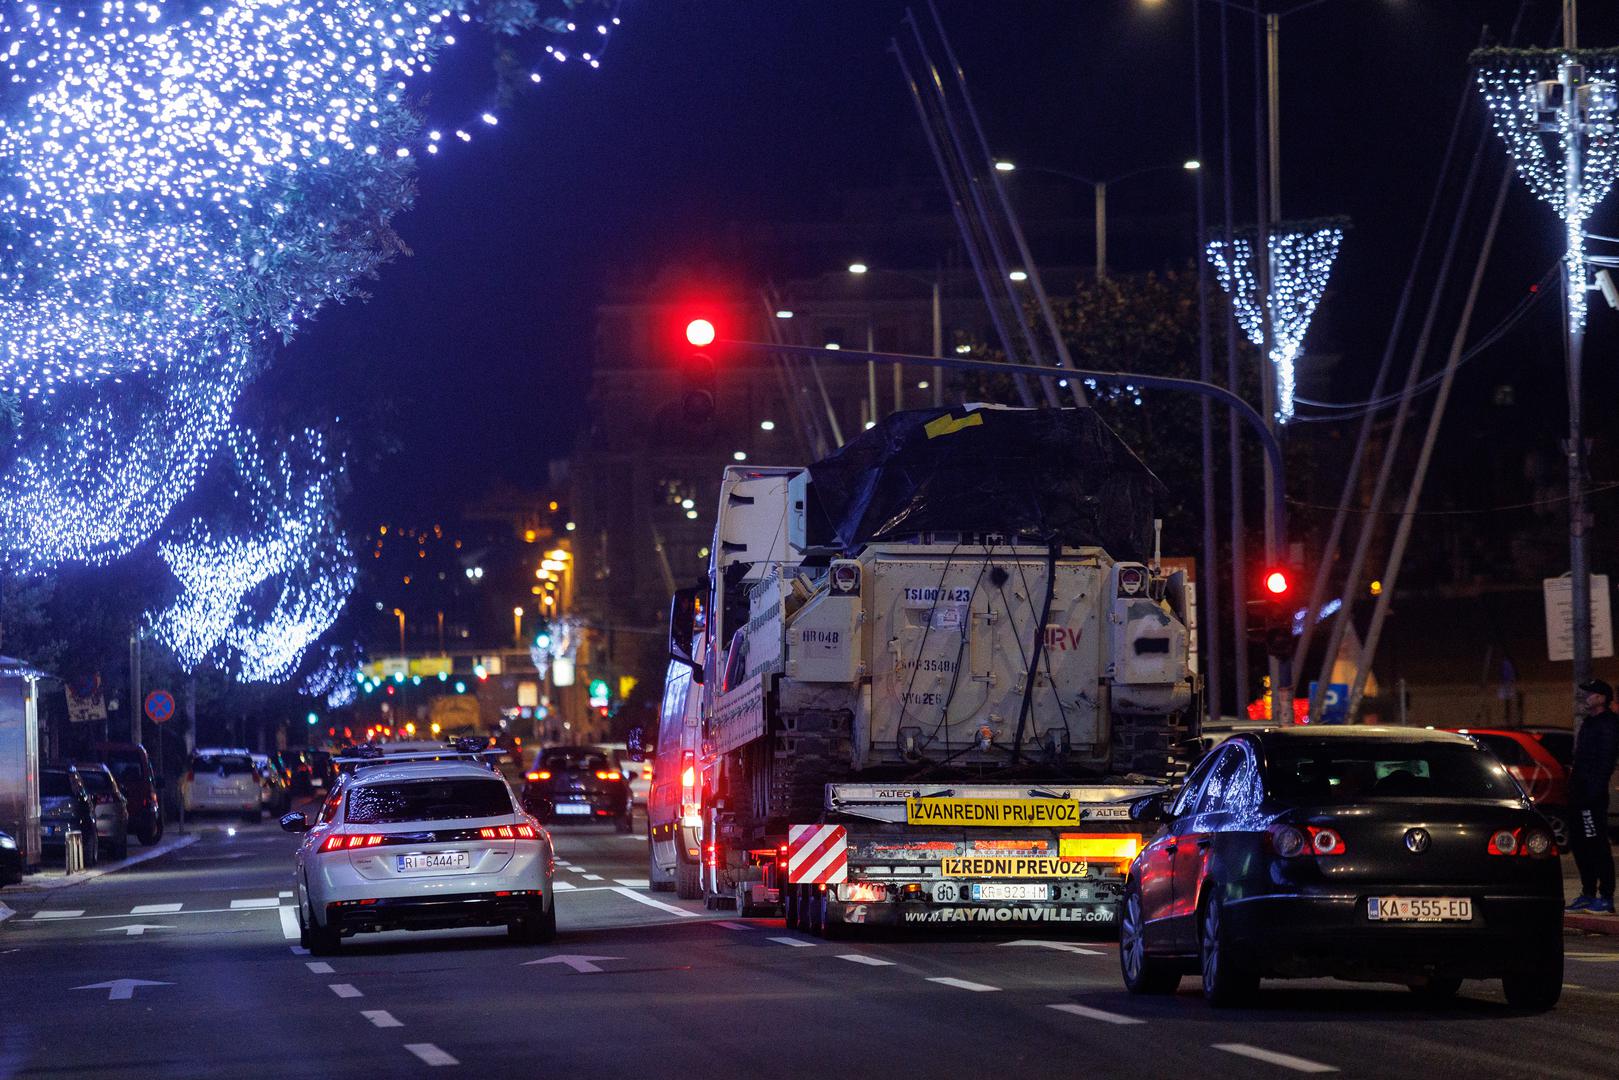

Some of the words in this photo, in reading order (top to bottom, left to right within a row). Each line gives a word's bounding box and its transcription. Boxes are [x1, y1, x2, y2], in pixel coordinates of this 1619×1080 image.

[879, 790, 911, 798] ALTEC
[910, 802, 999, 820] IZVANREDNI
[1003, 803, 1077, 821] PRIJEVOZ
[1096, 808, 1128, 817] ALTEC
[405, 857, 417, 868] RI
[426, 854, 465, 867] 6444-P
[945, 859, 1012, 874] IZREDNI
[1016, 859, 1081, 875] PREVOZ
[937, 885, 954, 901] 80
[1379, 901, 1399, 916] KA
[1411, 901, 1469, 917] 555-ED
